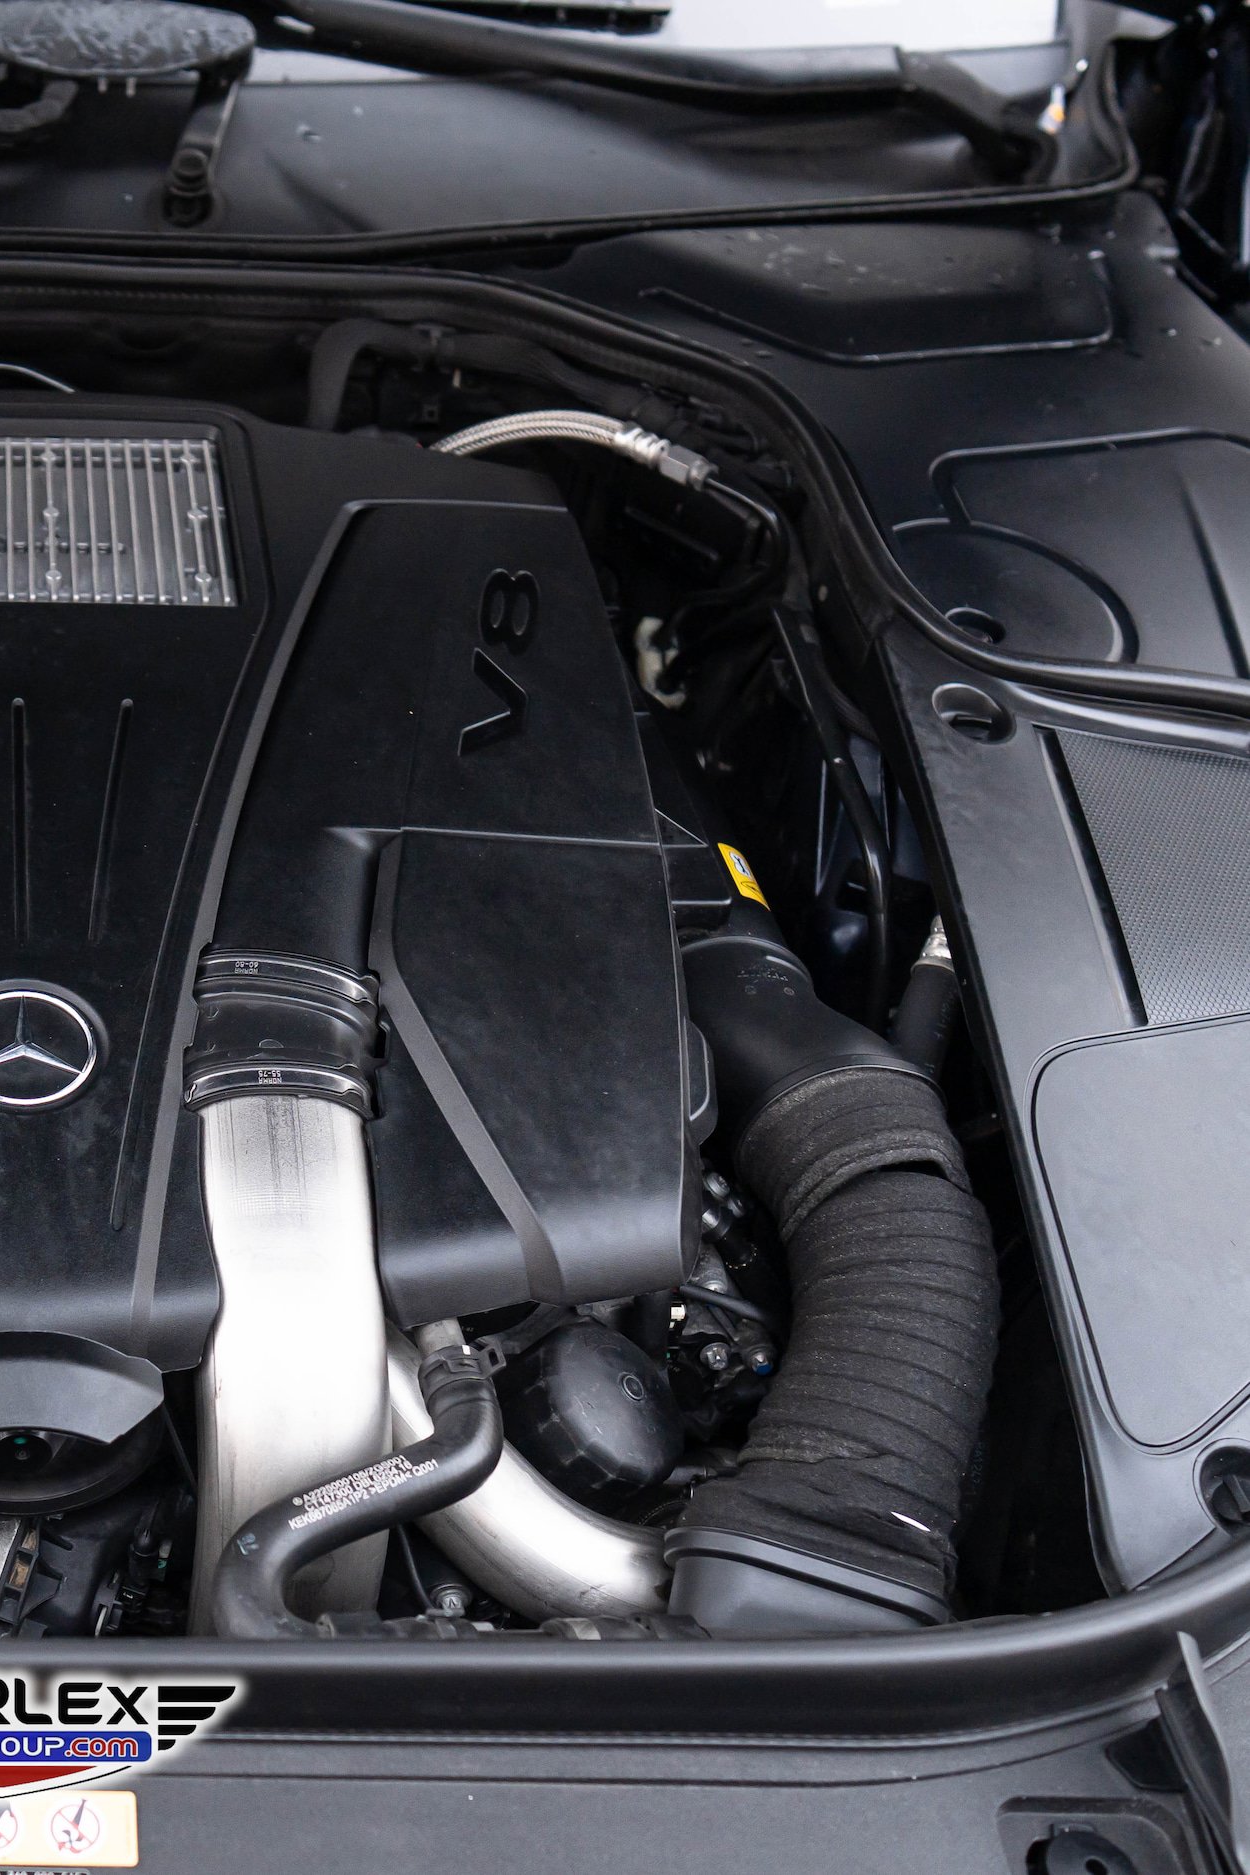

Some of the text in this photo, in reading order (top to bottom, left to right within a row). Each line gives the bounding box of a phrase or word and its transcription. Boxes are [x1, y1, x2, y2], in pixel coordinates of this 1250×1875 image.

[458, 567, 540, 757] V8
[258, 1077, 282, 1085] NORMA
[412, 1458, 439, 1477] Q001
